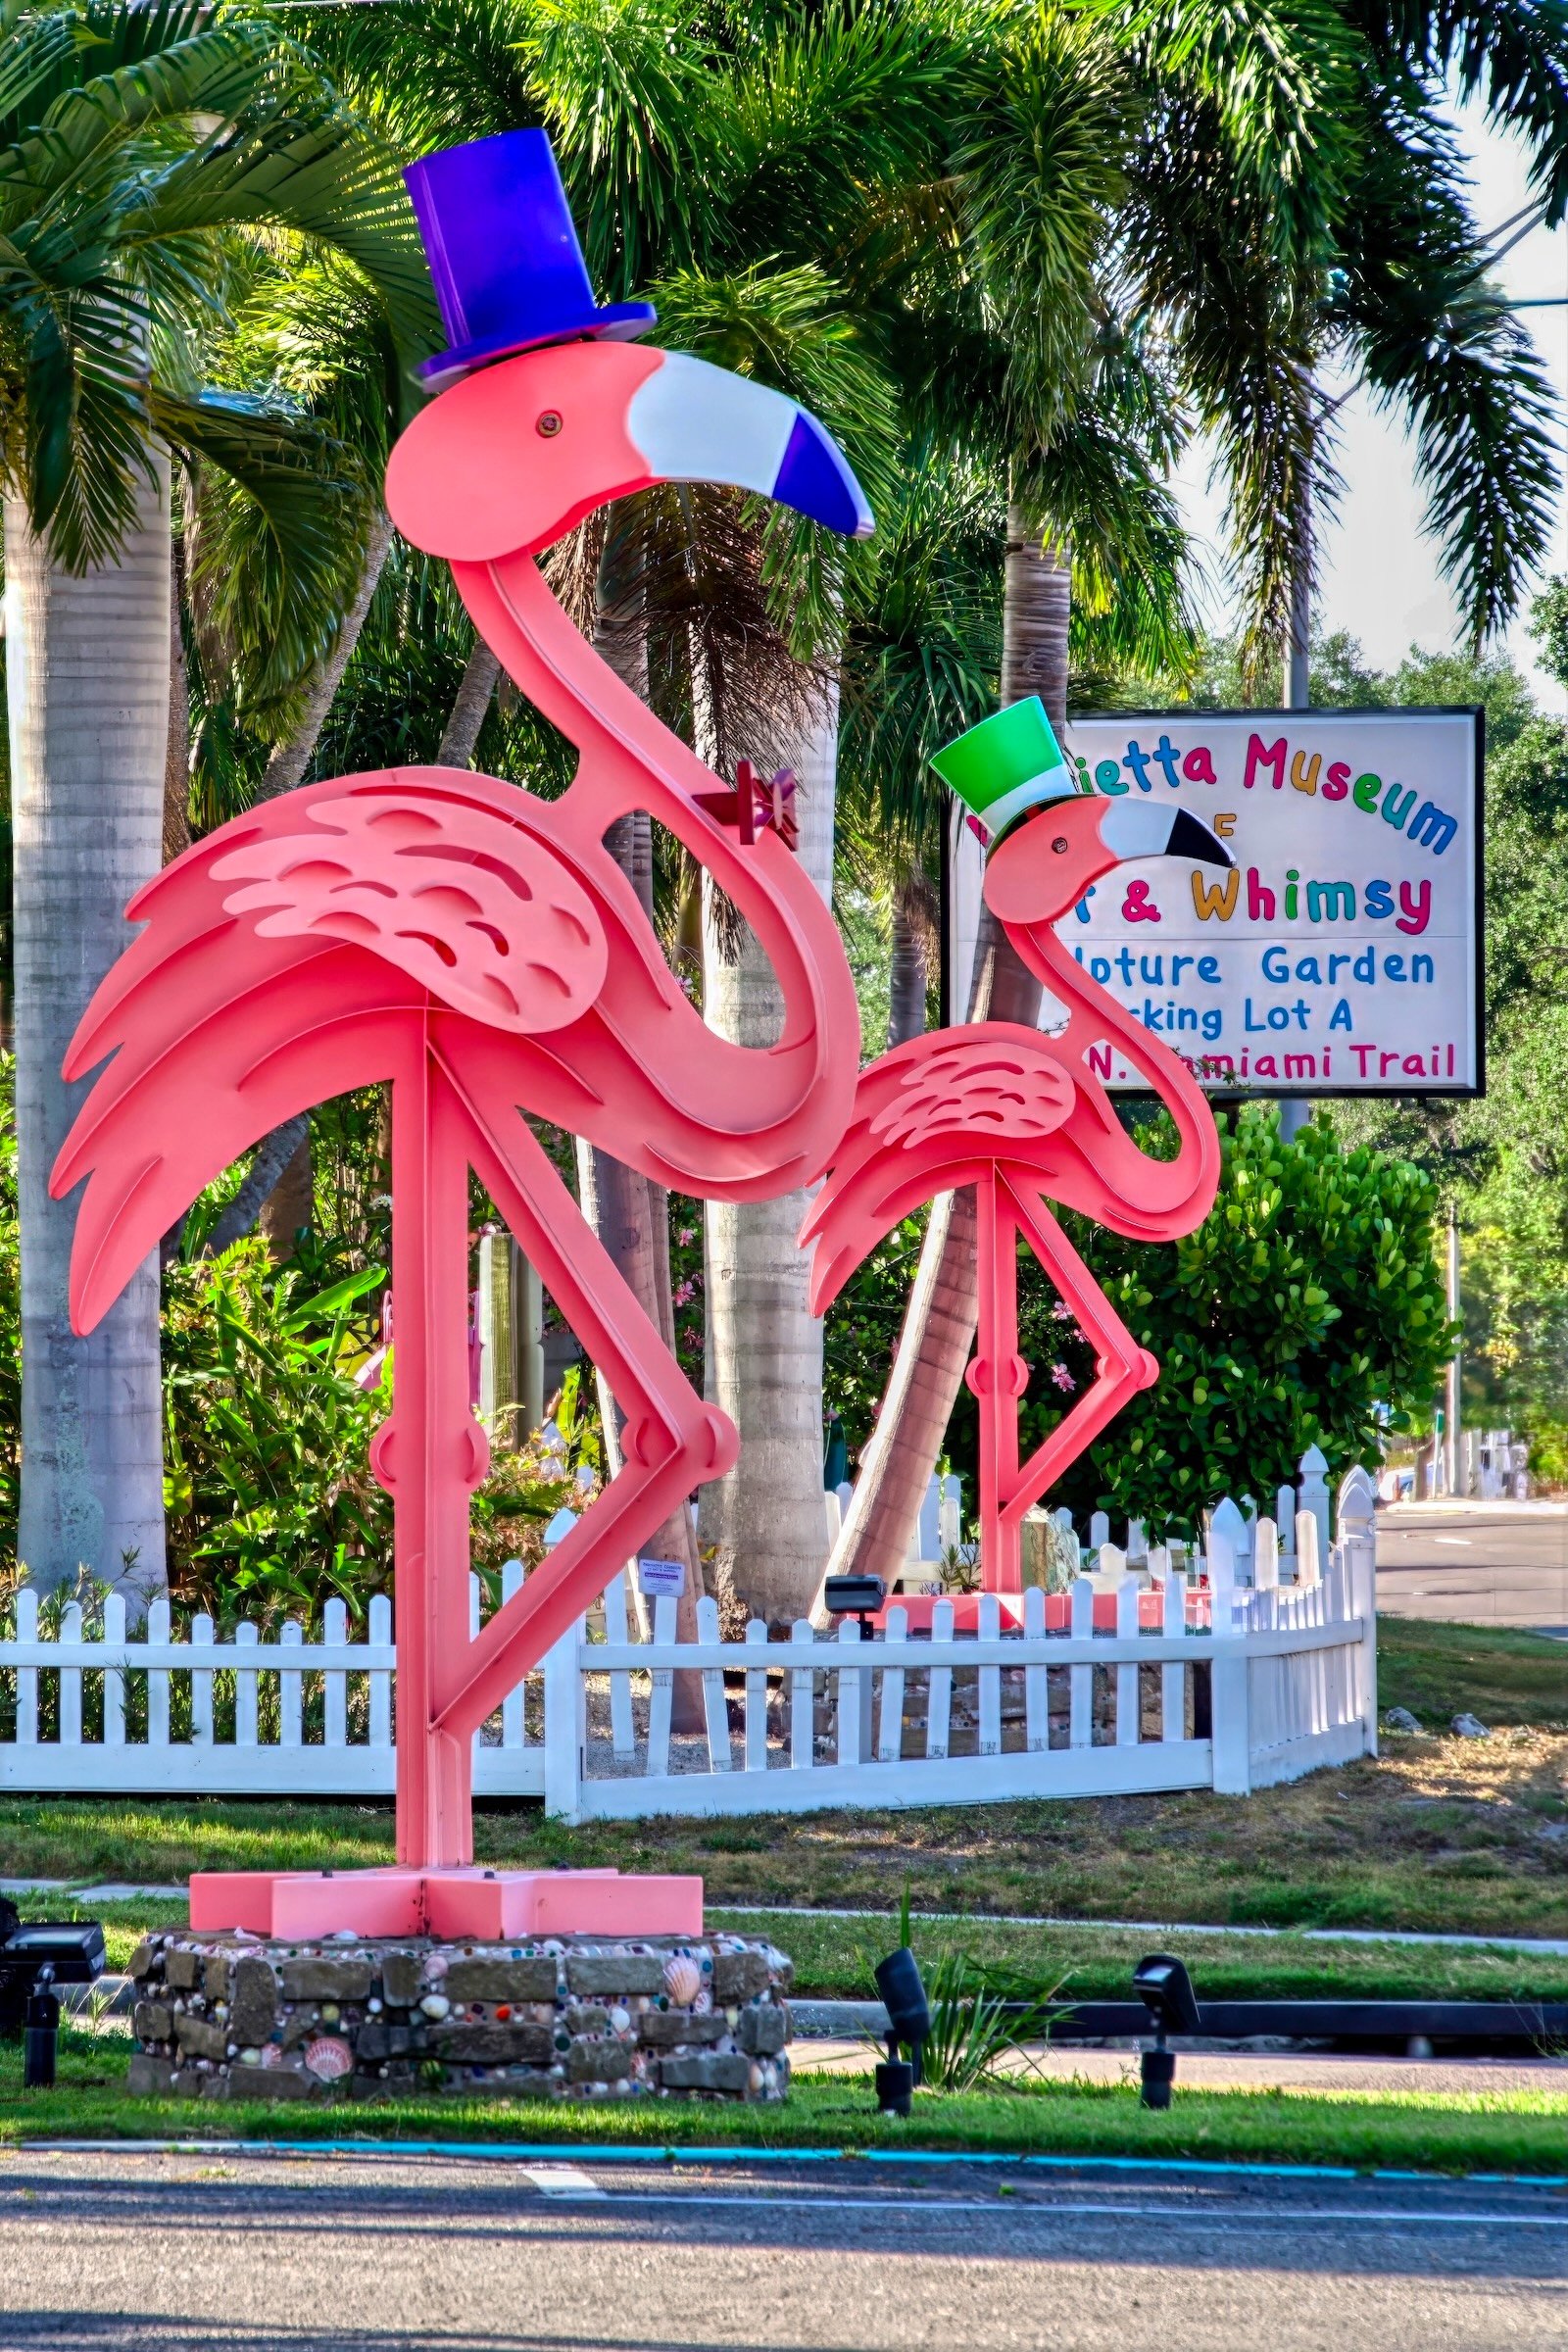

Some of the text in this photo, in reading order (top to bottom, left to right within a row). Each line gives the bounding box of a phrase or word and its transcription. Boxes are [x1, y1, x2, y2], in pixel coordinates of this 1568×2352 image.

[1075, 733, 1458, 856] ietta Museum
[1122, 880, 1161, 922] &
[1192, 867, 1432, 936] Whimsy
[1075, 946, 1434, 986] pture Garden
[1129, 998, 1352, 1041] king Lot A
[1089, 1044, 1454, 1080] N. miami Trail
